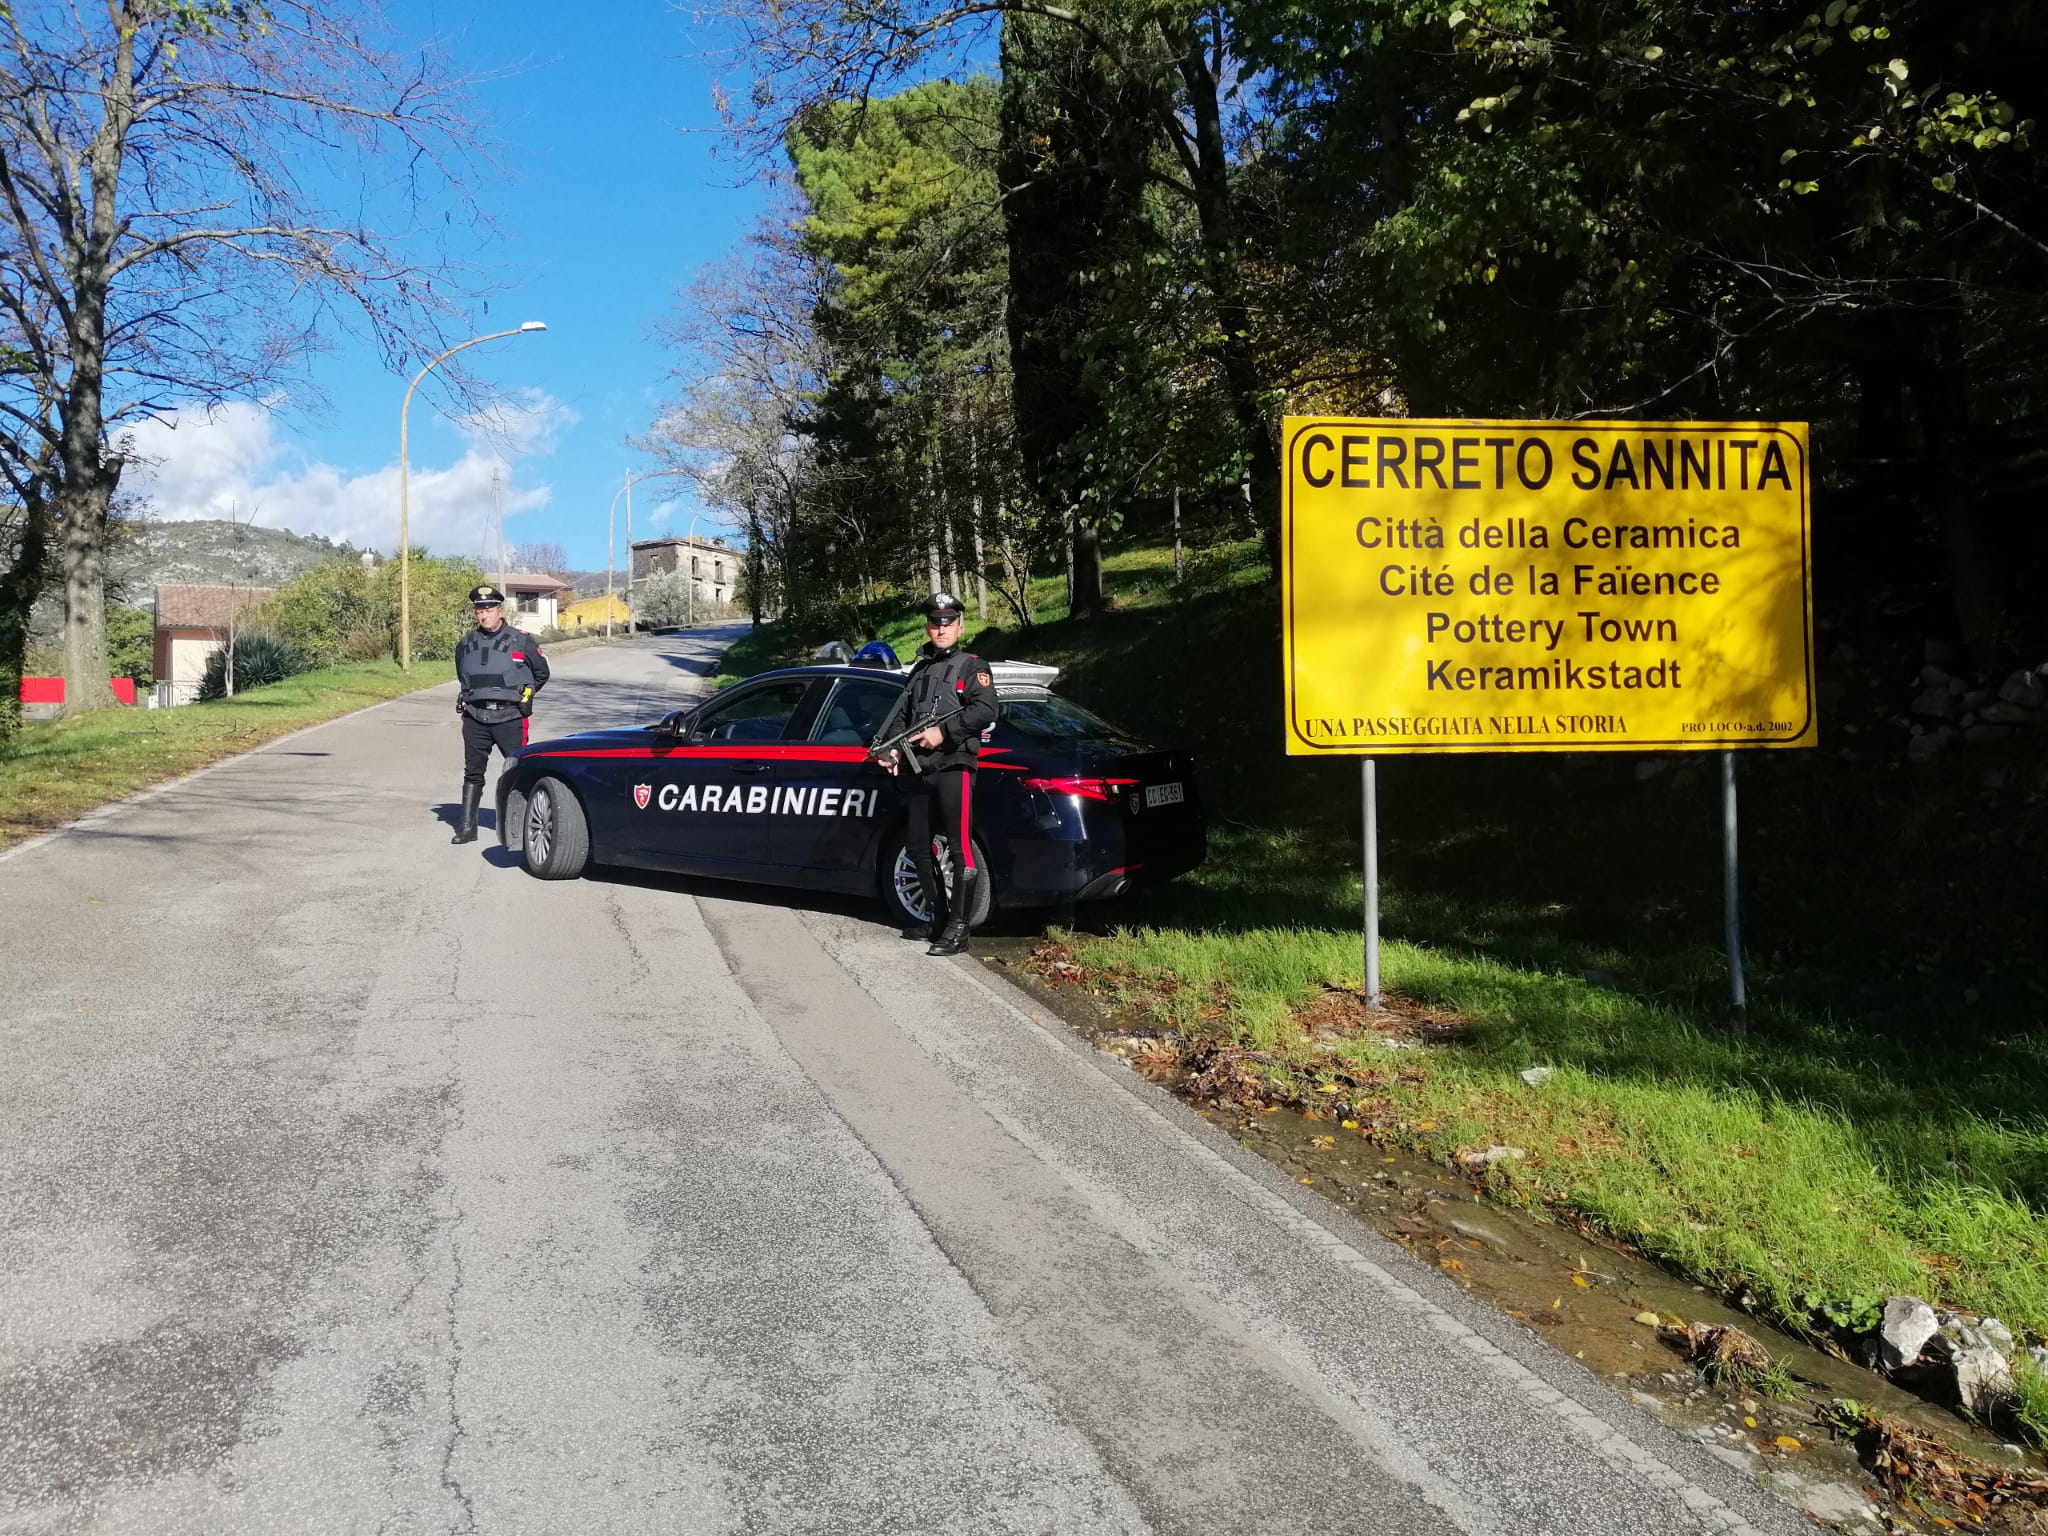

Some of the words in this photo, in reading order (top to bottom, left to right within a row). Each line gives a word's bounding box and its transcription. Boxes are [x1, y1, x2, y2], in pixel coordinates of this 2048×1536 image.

[1301, 433, 1554, 491] CERRETO
[1571, 437, 1792, 491] SANNITA
[1357, 517, 1443, 549] Città
[1460, 518, 1549, 548] della
[1564, 518, 1739, 549] Ceramica
[1380, 565, 1454, 596] Cité
[1470, 565, 1513, 595] de
[1529, 565, 1559, 595] la
[1574, 565, 1719, 595] Faïence
[1427, 613, 1564, 650] Pottery
[1578, 612, 1676, 642] Town
[1427, 659, 1681, 690] Keramikstadt
[1305, 719, 1347, 737] UNA
[1354, 718, 1482, 735] PASSEGGIATA
[1490, 717, 1549, 734] NELLA
[1557, 716, 1626, 733] STORIA
[1682, 722, 1706, 732] PRO
[1768, 721, 1793, 732] 2002
[658, 783, 878, 817] CARABINIERI
